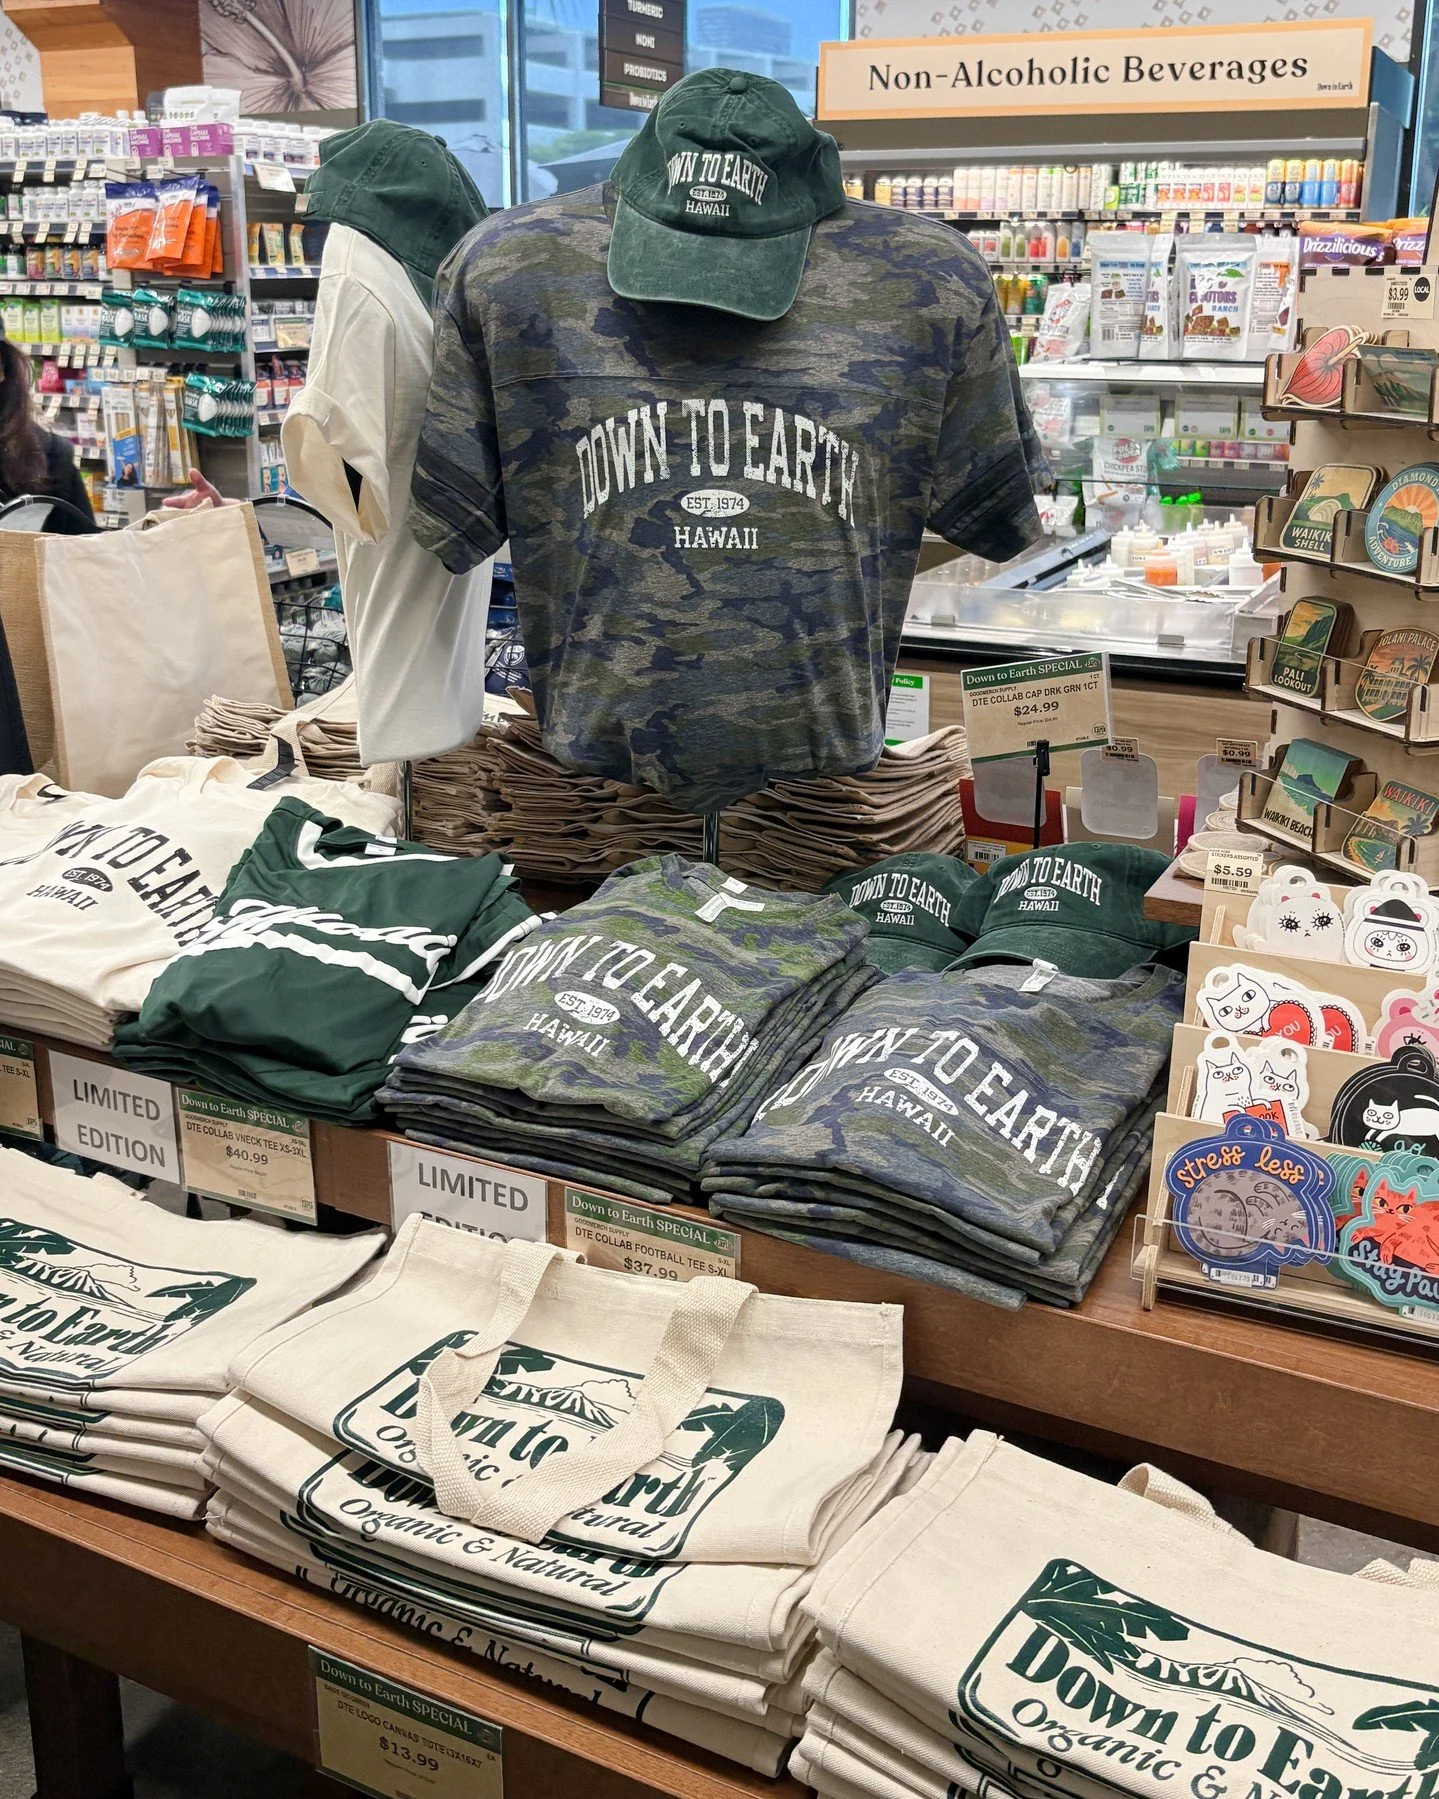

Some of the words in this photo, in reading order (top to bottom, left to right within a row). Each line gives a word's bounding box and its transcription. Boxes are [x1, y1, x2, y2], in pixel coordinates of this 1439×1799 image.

[627, 0, 663, 18] TURMERIC
[635, 33, 655, 48] NONI
[624, 63, 667, 82] PROBIOTICS
[869, 56, 1110, 90] Non-Alcoholic
[1123, 55, 1308, 85] Beverages
[699, 153, 721, 182] TO
[721, 153, 768, 206] EARTH
[685, 200, 730, 217] HAWAII
[1303, 236, 1377, 257] Drizzilicious
[1388, 287, 1409, 301] $3.99
[1414, 285, 1430, 294] LOCAL
[1211, 304, 1239, 313] RANCH
[576, 401, 668, 519] DOWN
[682, 398, 730, 477] TO
[743, 401, 860, 528] EARTH
[1393, 472, 1438, 491] DIAMOND
[686, 496, 714, 511] EST.
[716, 496, 745, 511] 1974
[674, 526, 759, 549] HAWAII
[1292, 527, 1332, 543] WAIKIK
[1294, 539, 1326, 552] SHELL
[1369, 535, 1412, 567] ADVENTURE
[1408, 633, 1438, 652] PALACE
[895, 677, 915, 686] Policy
[966, 673, 995, 685] Down
[997, 671, 1007, 680] to
[1009, 667, 1036, 679] Earth
[1038, 659, 1082, 674] SPECIAL
[1274, 675, 1311, 693] LOOKOUT
[1283, 667, 1305, 681] PALI
[972, 697, 989, 707] DTE
[990, 691, 1024, 705] COLLAB
[1025, 689, 1042, 700] CAP
[1044, 686, 1062, 697] DRK
[1063, 683, 1081, 694] GRN
[1084, 681, 1099, 690] 1CT
[999, 685, 1017, 693] SUPPLY
[1014, 701, 1059, 717] $24.99
[1222, 748, 1251, 758] $0.99
[1382, 784, 1435, 816] WAIKIKI
[1263, 807, 1290, 828] WAIKIKI
[91, 826, 170, 869] TO
[1234, 854, 1258, 862] ASSORTED
[66, 869, 85, 881] EST.
[86, 872, 108, 890] 1974
[1030, 857, 1052, 884] TO
[1050, 857, 1102, 906] EARTH
[1213, 863, 1253, 878] $5.59
[26, 885, 99, 911] HAWAII
[849, 873, 888, 908] DOWN
[888, 873, 909, 898] TO
[908, 877, 951, 928] EARTH
[1018, 901, 1059, 911] HAWAII
[876, 912, 915, 925] HAWAII
[559, 993, 586, 1012] EST.
[587, 1004, 616, 1021] 1974
[583, 940, 656, 990] TO
[631, 962, 759, 1088] EARTH
[523, 1012, 610, 1057] HAWAII
[1275, 1021, 1301, 1039] YOU
[2, 1064, 15, 1075] TEE
[16, 1067, 31, 1078] S-XL
[73, 1079, 160, 1122] LIMITED
[889, 1069, 919, 1089] EST.
[921, 1085, 954, 1111] 1974
[182, 1094, 208, 1110] Down
[209, 1102, 219, 1112] to
[220, 1104, 246, 1118] Earth
[247, 1109, 290, 1128] SPECIAL
[855, 1086, 955, 1147] HAWAII
[910, 1030, 979, 1085] TO
[964, 1061, 1102, 1196] EARTH
[78, 1124, 166, 1168] EDITION
[187, 1122, 201, 1133] DTE
[203, 1126, 233, 1140] COLLAB
[235, 1132, 262, 1147] VNECK
[263, 1140, 278, 1150] TEE
[280, 1143, 307, 1158] XS-3XL
[1394, 1139, 1426, 1157] go
[226, 1145, 268, 1165] $40.99
[1176, 1145, 1246, 1189] stress
[1254, 1145, 1305, 1184] less
[418, 1162, 528, 1212] LIMITED
[572, 1195, 605, 1216] Down
[607, 1208, 620, 1219] to
[622, 1210, 655, 1229] Earth
[656, 1218, 711, 1245] SPECIAL
[574, 1217, 608, 1232] GOODMERCH
[608, 1227, 629, 1237] SUPPLY
[575, 1226, 593, 1240] DTE
[595, 1231, 633, 1251] COLLAB
[634, 1243, 684, 1267] FOOTBALL
[687, 1257, 706, 1272] TEE
[707, 1264, 730, 1278] S-XL
[624, 1256, 678, 1282] $37.99
[1, 1296, 57, 1332] to
[38, 1305, 170, 1355] Earth
[6, 1340, 121, 1371] Natural
[380, 1377, 517, 1449] Dwn
[509, 1420, 569, 1470] to
[339, 1498, 463, 1546] Organic
[462, 1538, 493, 1556] &
[490, 1547, 631, 1597] Natural
[320, 1659, 357, 1686] Down
[359, 1675, 372, 1693] to
[375, 1683, 410, 1709] Earth
[412, 1700, 473, 1735] SPECIAL
[1005, 1622, 1179, 1745] Down
[1186, 1703, 1256, 1762] to
[337, 1699, 354, 1715] DTE
[356, 1707, 381, 1727] LOGO
[383, 1721, 419, 1744] CANVAS
[379, 1735, 439, 1772] $13.99
[1012, 1698, 1182, 1781] Organic
[1190, 1764, 1228, 1799] &
